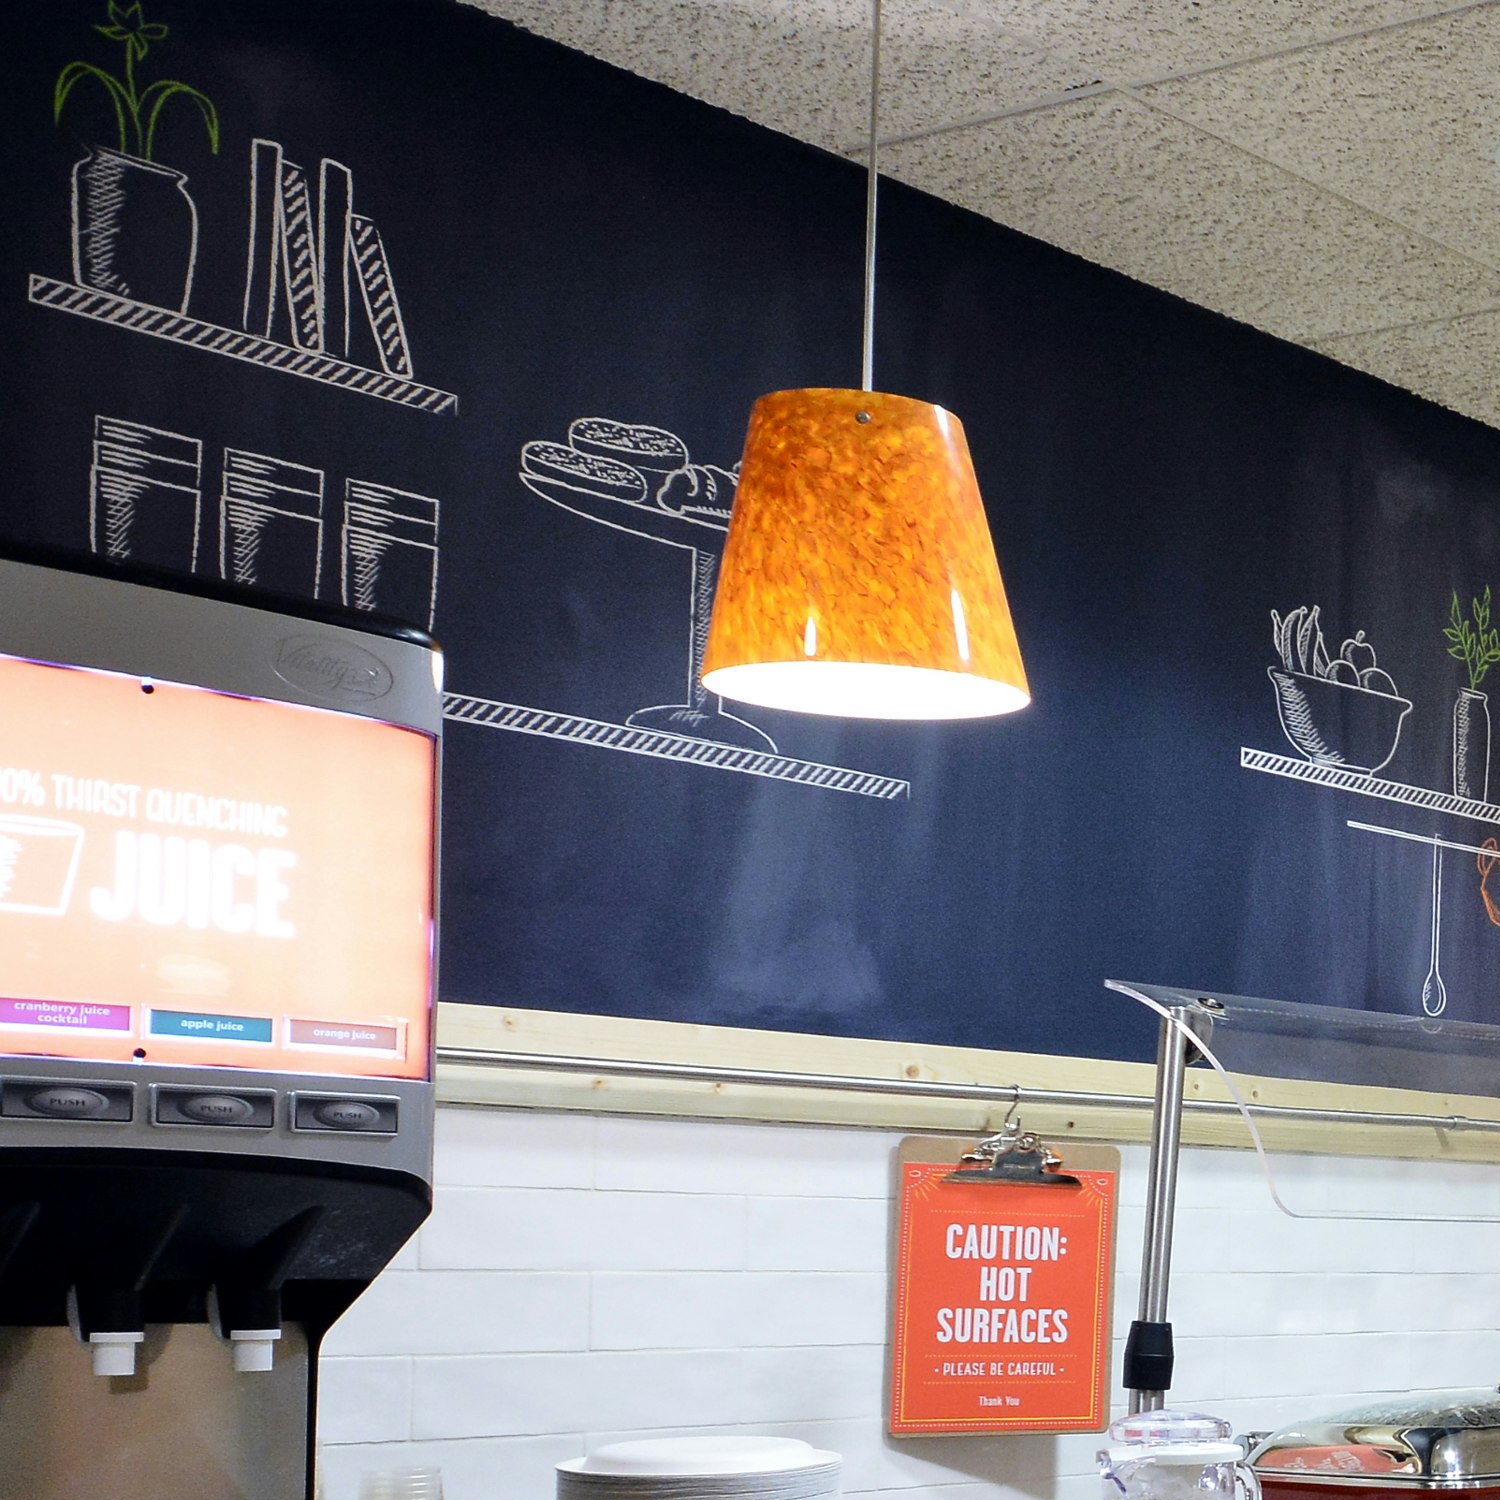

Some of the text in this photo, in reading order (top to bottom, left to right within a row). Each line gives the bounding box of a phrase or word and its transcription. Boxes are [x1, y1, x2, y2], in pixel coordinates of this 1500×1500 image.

[0, 768, 289, 838] 0% THIRST QUENCHING
[89, 829, 297, 939] JUICE
[14, 1001, 110, 1019] cranberry juice
[37, 1012, 88, 1026] cocktail
[180, 1018, 245, 1033] apple juice
[313, 1027, 377, 1041] orange juice
[49, 1096, 86, 1108] PUSH
[200, 1103, 233, 1114] PUSH
[333, 1110, 363, 1120] PUSH
[945, 1223, 1068, 1261] CAUTION:
[979, 1266, 1033, 1302] HOT
[936, 1307, 1069, 1344] SURFACES
[943, 1362, 1056, 1376] PLEASE BE CAREFUL
[979, 1396, 1020, 1407] Thank You
